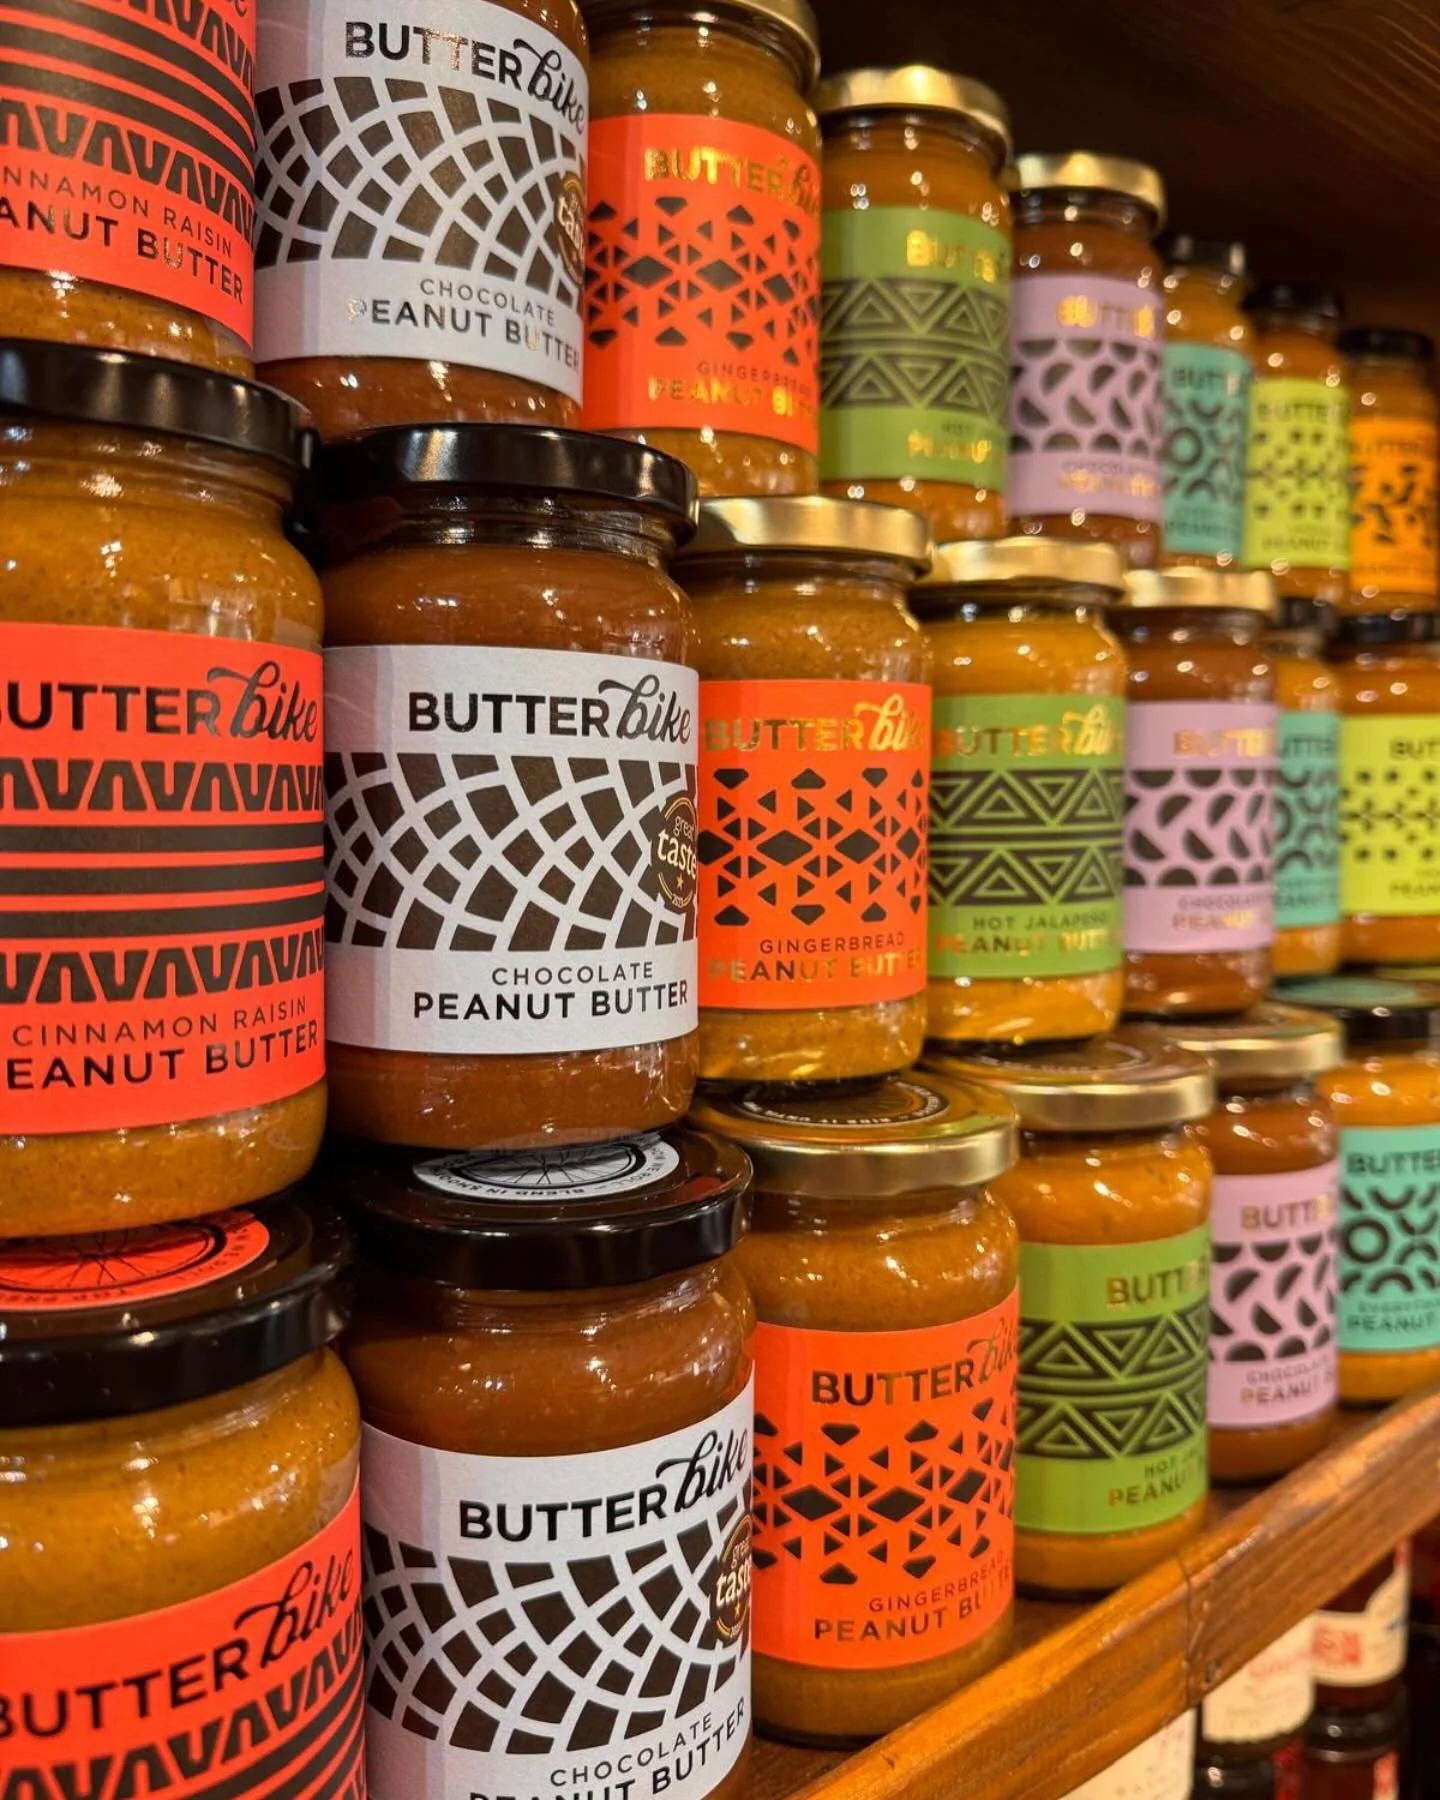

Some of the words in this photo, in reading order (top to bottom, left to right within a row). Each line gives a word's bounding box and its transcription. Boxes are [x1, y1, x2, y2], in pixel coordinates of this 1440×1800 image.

[345, 21, 522, 91] BUTTER
[513, 38, 585, 134] bike
[3, 166, 149, 218] NNAMON
[163, 207, 232, 259] RAISIN
[137, 228, 243, 304] BUTTER
[348, 298, 493, 338] PEANUT
[419, 278, 555, 328] CHOCOLATE
[0, 681, 222, 737] UTTER
[206, 660, 319, 743] bike
[409, 692, 611, 738] BUTTER
[598, 674, 692, 745] bike
[704, 716, 865, 752] BUTTER
[759, 931, 905, 954] GINGERBREAD
[972, 915, 1016, 931] HOT
[492, 961, 653, 986] CHOCOLATE
[708, 958, 838, 984] PEANUT
[12, 1012, 218, 1048] CINNAMON
[233, 996, 307, 1031] RAISIN
[413, 992, 576, 1021] PEANUT
[591, 979, 688, 1018] BUTTER
[6, 1048, 185, 1091] EANUT
[205, 1019, 318, 1075] BUTTER
[811, 1357, 975, 1407] BUTTER
[460, 1483, 668, 1543] BUTTER
[655, 1427, 749, 1514] bike
[233, 1547, 354, 1670] bike
[814, 1605, 948, 1642] PEANUT
[550, 1711, 713, 1787] CHOCOLATE
[651, 1696, 745, 1796] BUTTER
